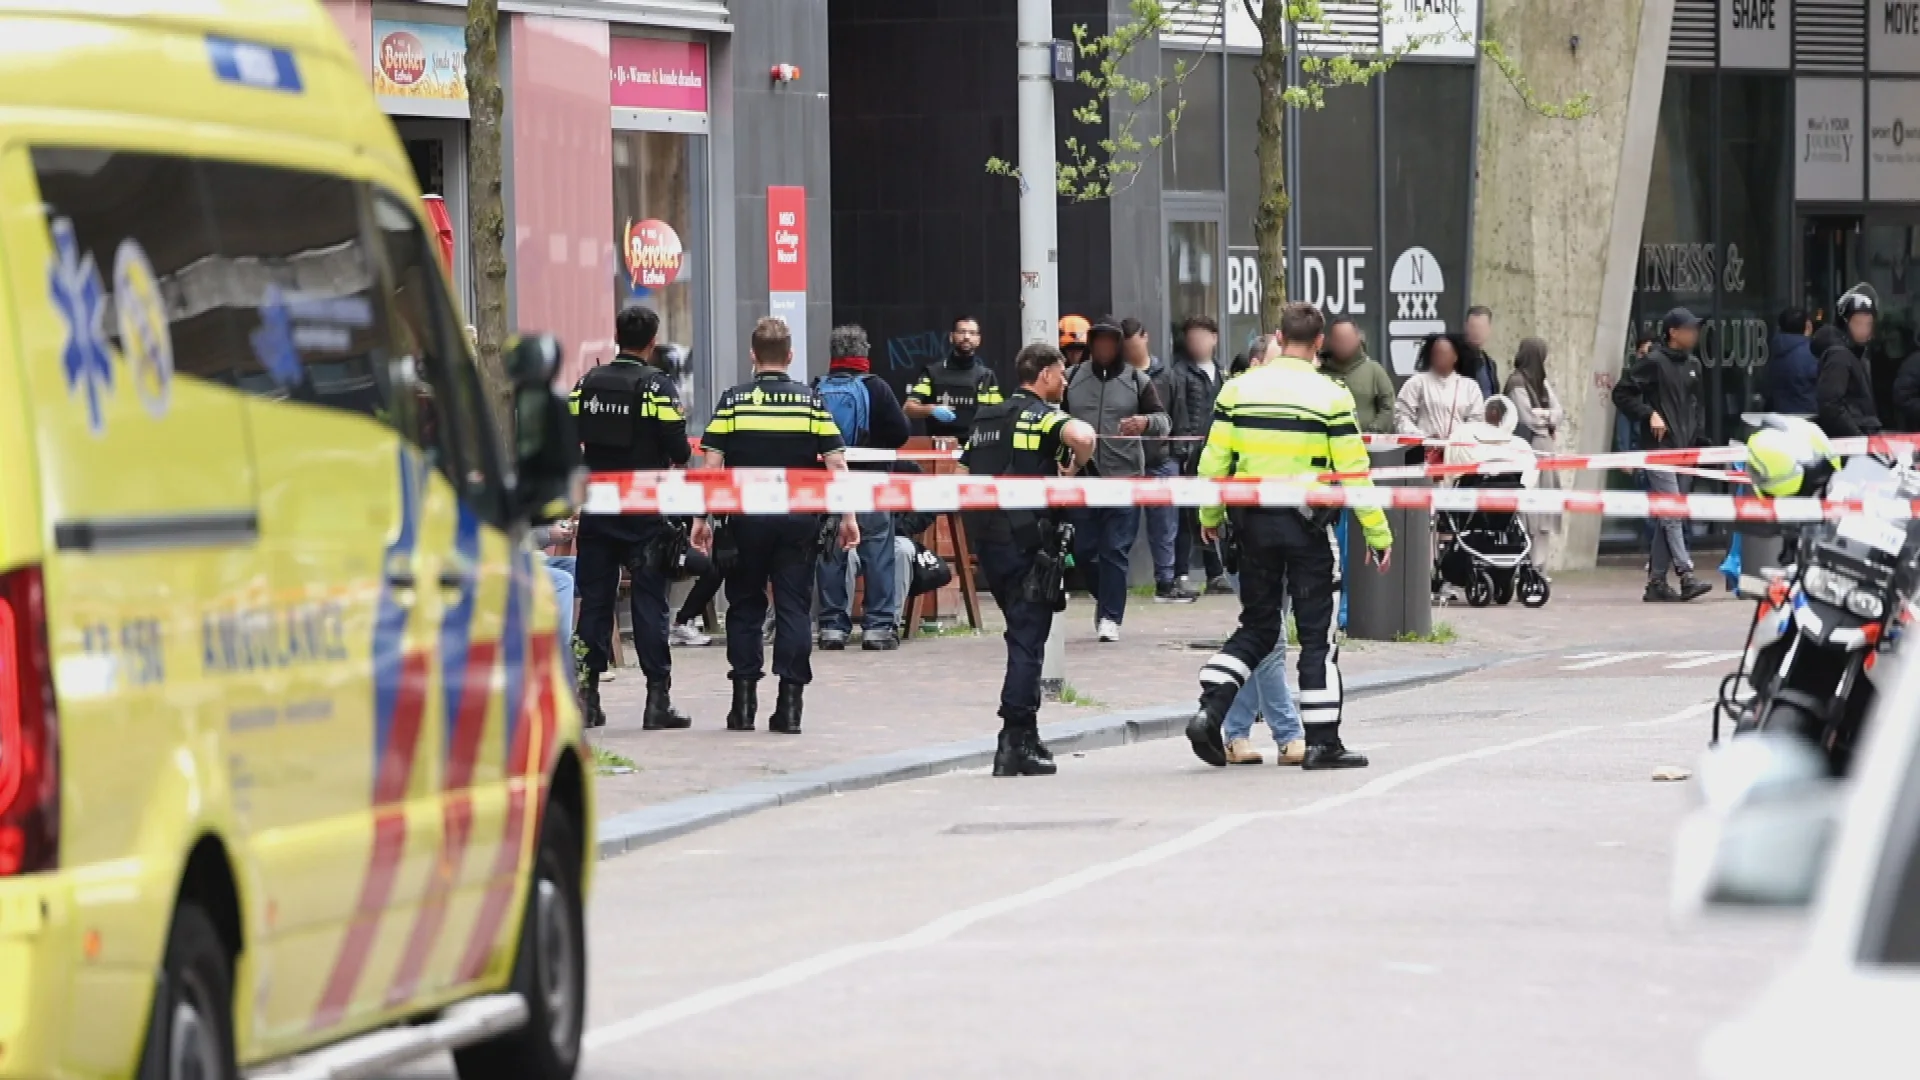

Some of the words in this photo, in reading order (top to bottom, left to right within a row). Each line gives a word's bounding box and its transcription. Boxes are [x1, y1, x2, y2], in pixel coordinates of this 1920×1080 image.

[1732, 0, 1776, 30] SHAPE
[1884, 2, 1919, 35] MOVE
[775, 229, 799, 248] College
[1227, 257, 1366, 315] BRDJE
[1722, 243, 1745, 292] &
[1700, 319, 1770, 369] CLUB
